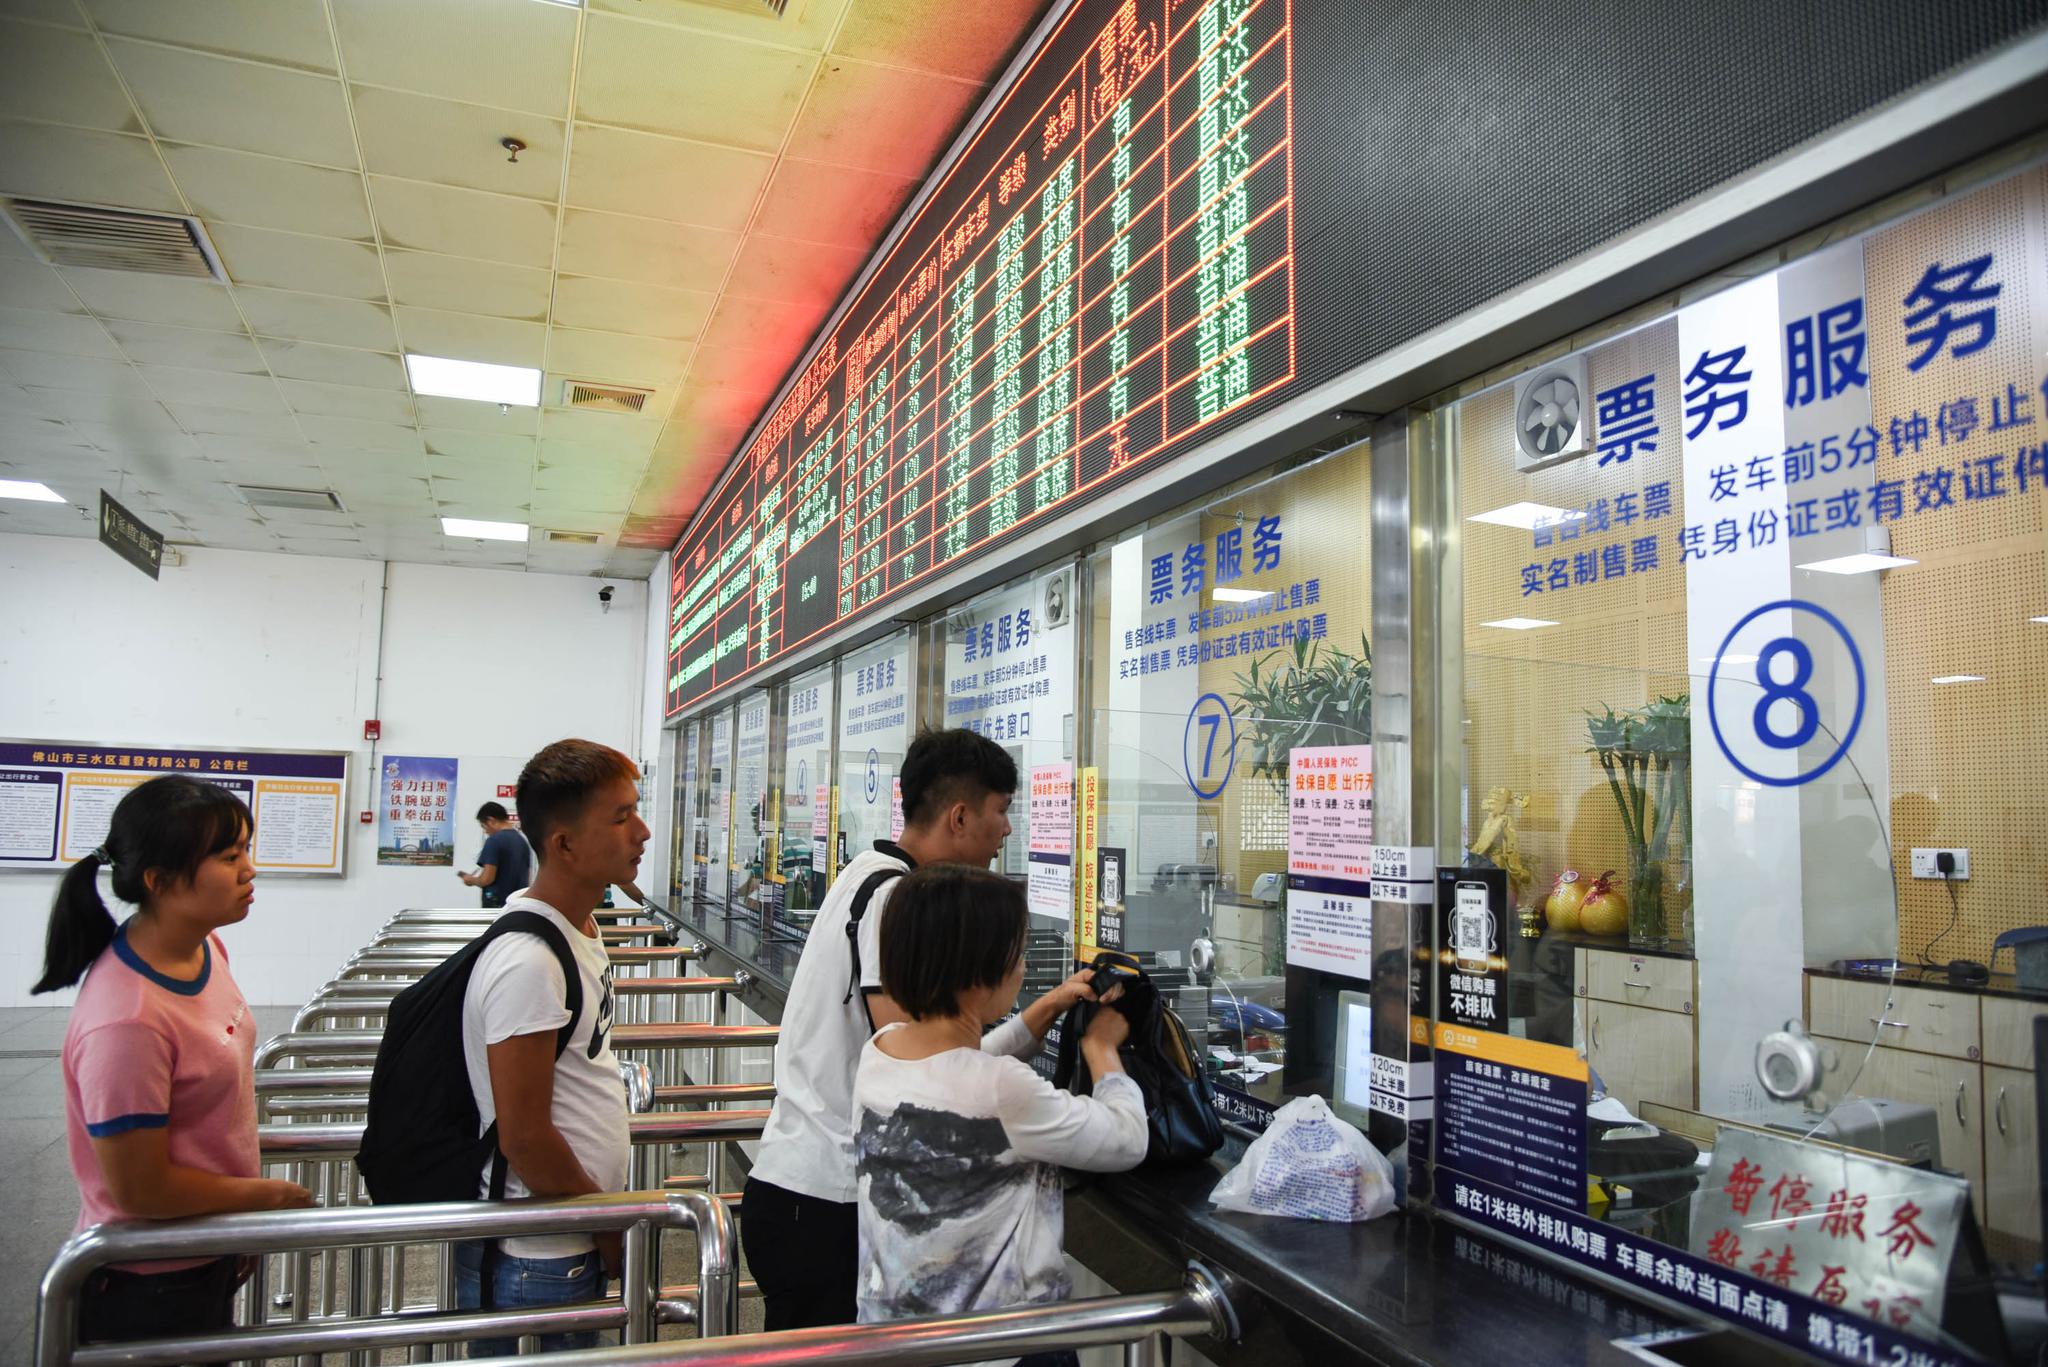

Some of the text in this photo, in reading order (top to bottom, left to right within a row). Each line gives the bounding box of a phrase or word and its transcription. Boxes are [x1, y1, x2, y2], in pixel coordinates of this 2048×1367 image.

[951, 300, 974, 351] 大型
[995, 247, 1023, 309] 高级
[1041, 197, 1073, 266] 座席
[1111, 134, 1131, 195] 有
[1198, 10, 1248, 112] 直达
[951, 262, 975, 319] 大型
[996, 208, 1024, 272] 高级
[1041, 154, 1074, 224] 座席
[1112, 87, 1131, 150] 有
[998, 146, 1026, 214] 等级
[950, 334, 972, 385] 大型
[994, 286, 1022, 345] 高级
[1040, 239, 1072, 306] 座席
[1111, 180, 1130, 239] 有
[1198, 62, 1249, 161] 直达
[900, 254, 937, 326] 执行票价
[948, 369, 971, 421] 大型
[993, 325, 1021, 384] 高级
[1039, 281, 1071, 346] 座席
[1111, 226, 1130, 284] 有
[1198, 117, 1248, 212] 直达
[904, 451, 919, 486] 120
[947, 406, 970, 457] 大型
[992, 365, 1020, 423] 高级
[1038, 323, 1070, 387] 座席
[1110, 273, 1129, 330] 有
[1195, 172, 1248, 266] 普通
[903, 484, 917, 518] 110
[946, 442, 969, 492] 大型
[990, 405, 1019, 460] 高级
[1038, 367, 1070, 428] 座席
[1110, 321, 1128, 377] 有
[1195, 227, 1249, 319] 普通
[1596, 252, 2002, 467] 票务服务
[904, 519, 914, 548] 75
[945, 479, 968, 526] 大型
[990, 444, 1018, 499] 高级
[1036, 410, 1068, 469] 座席
[1109, 368, 1128, 423] 有
[1195, 284, 1249, 372] 普通
[903, 551, 914, 581] 72
[944, 515, 967, 557] 大型
[989, 484, 1016, 535] 高级
[1035, 454, 1067, 510] 座席
[1107, 422, 1130, 473] 无
[1196, 341, 1249, 425] 普通
[1149, 515, 1283, 606] 票务服务
[1520, 534, 1659, 598] 实名制售票
[964, 607, 1031, 664] 票务服务
[1119, 612, 1328, 681] 实名制售票 凭身份证或有效证件购票
[1125, 617, 1177, 651] 售各线车票
[856, 658, 897, 697] 票务服务
[1753, 636, 1820, 750] 8
[209, 760, 249, 771] 公告栏
[1199, 713, 1222, 779] 7
[1341, 757, 1358, 768] PICC
[391, 779, 448, 792] 强力扫黑
[391, 795, 447, 807] 铁腕惩恶
[868, 759, 876, 793] 5
[1296, 774, 1337, 791] 投保自愿
[390, 809, 446, 822] 重拳治乱
[1084, 776, 1095, 938] 投保自愿 旅途平安
[1372, 863, 1408, 878] 以上全票
[1374, 848, 1406, 861] 150cm
[1323, 899, 1353, 912] 温馨提示
[1372, 883, 1408, 900] 以下半票
[1101, 928, 1120, 943] 不排队
[1450, 974, 1496, 995] 微信购票
[1450, 992, 1496, 1020] 不排队
[1370, 1072, 1405, 1094] 以上半票
[1372, 1057, 1403, 1076] 120cm
[1370, 1093, 1405, 1116] 以下免费
[1724, 1157, 1936, 1263] 暂停服务
[1454, 1184, 1607, 1260] 请在1米线外排队购票
[1615, 1243, 1790, 1332] 车票余款当面点清
